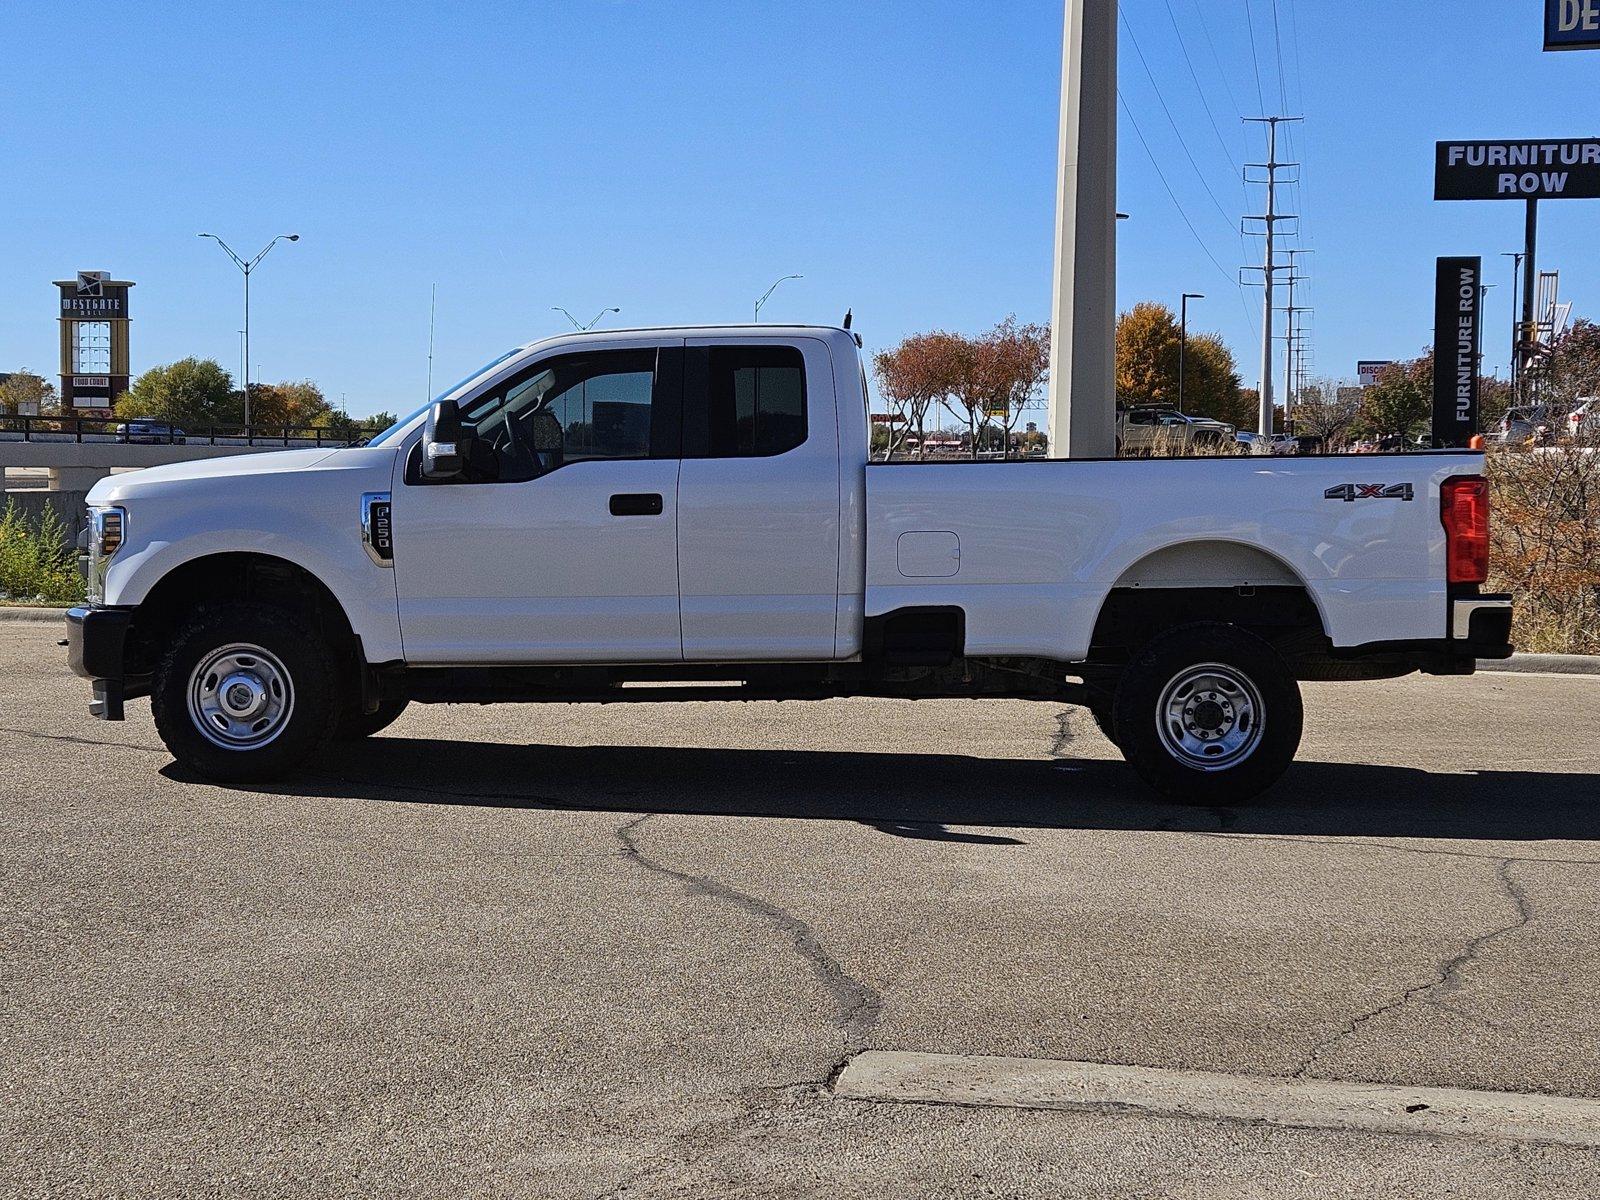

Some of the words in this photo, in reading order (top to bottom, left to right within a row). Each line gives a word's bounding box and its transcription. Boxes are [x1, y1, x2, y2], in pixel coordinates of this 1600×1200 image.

[1449, 144, 1600, 166] FURNITUR
[1498, 172, 1568, 193] ROW
[1460, 267, 1475, 312] ROW
[62, 299, 120, 310] WESTGATE
[1456, 316, 1473, 421] FURNITURE
